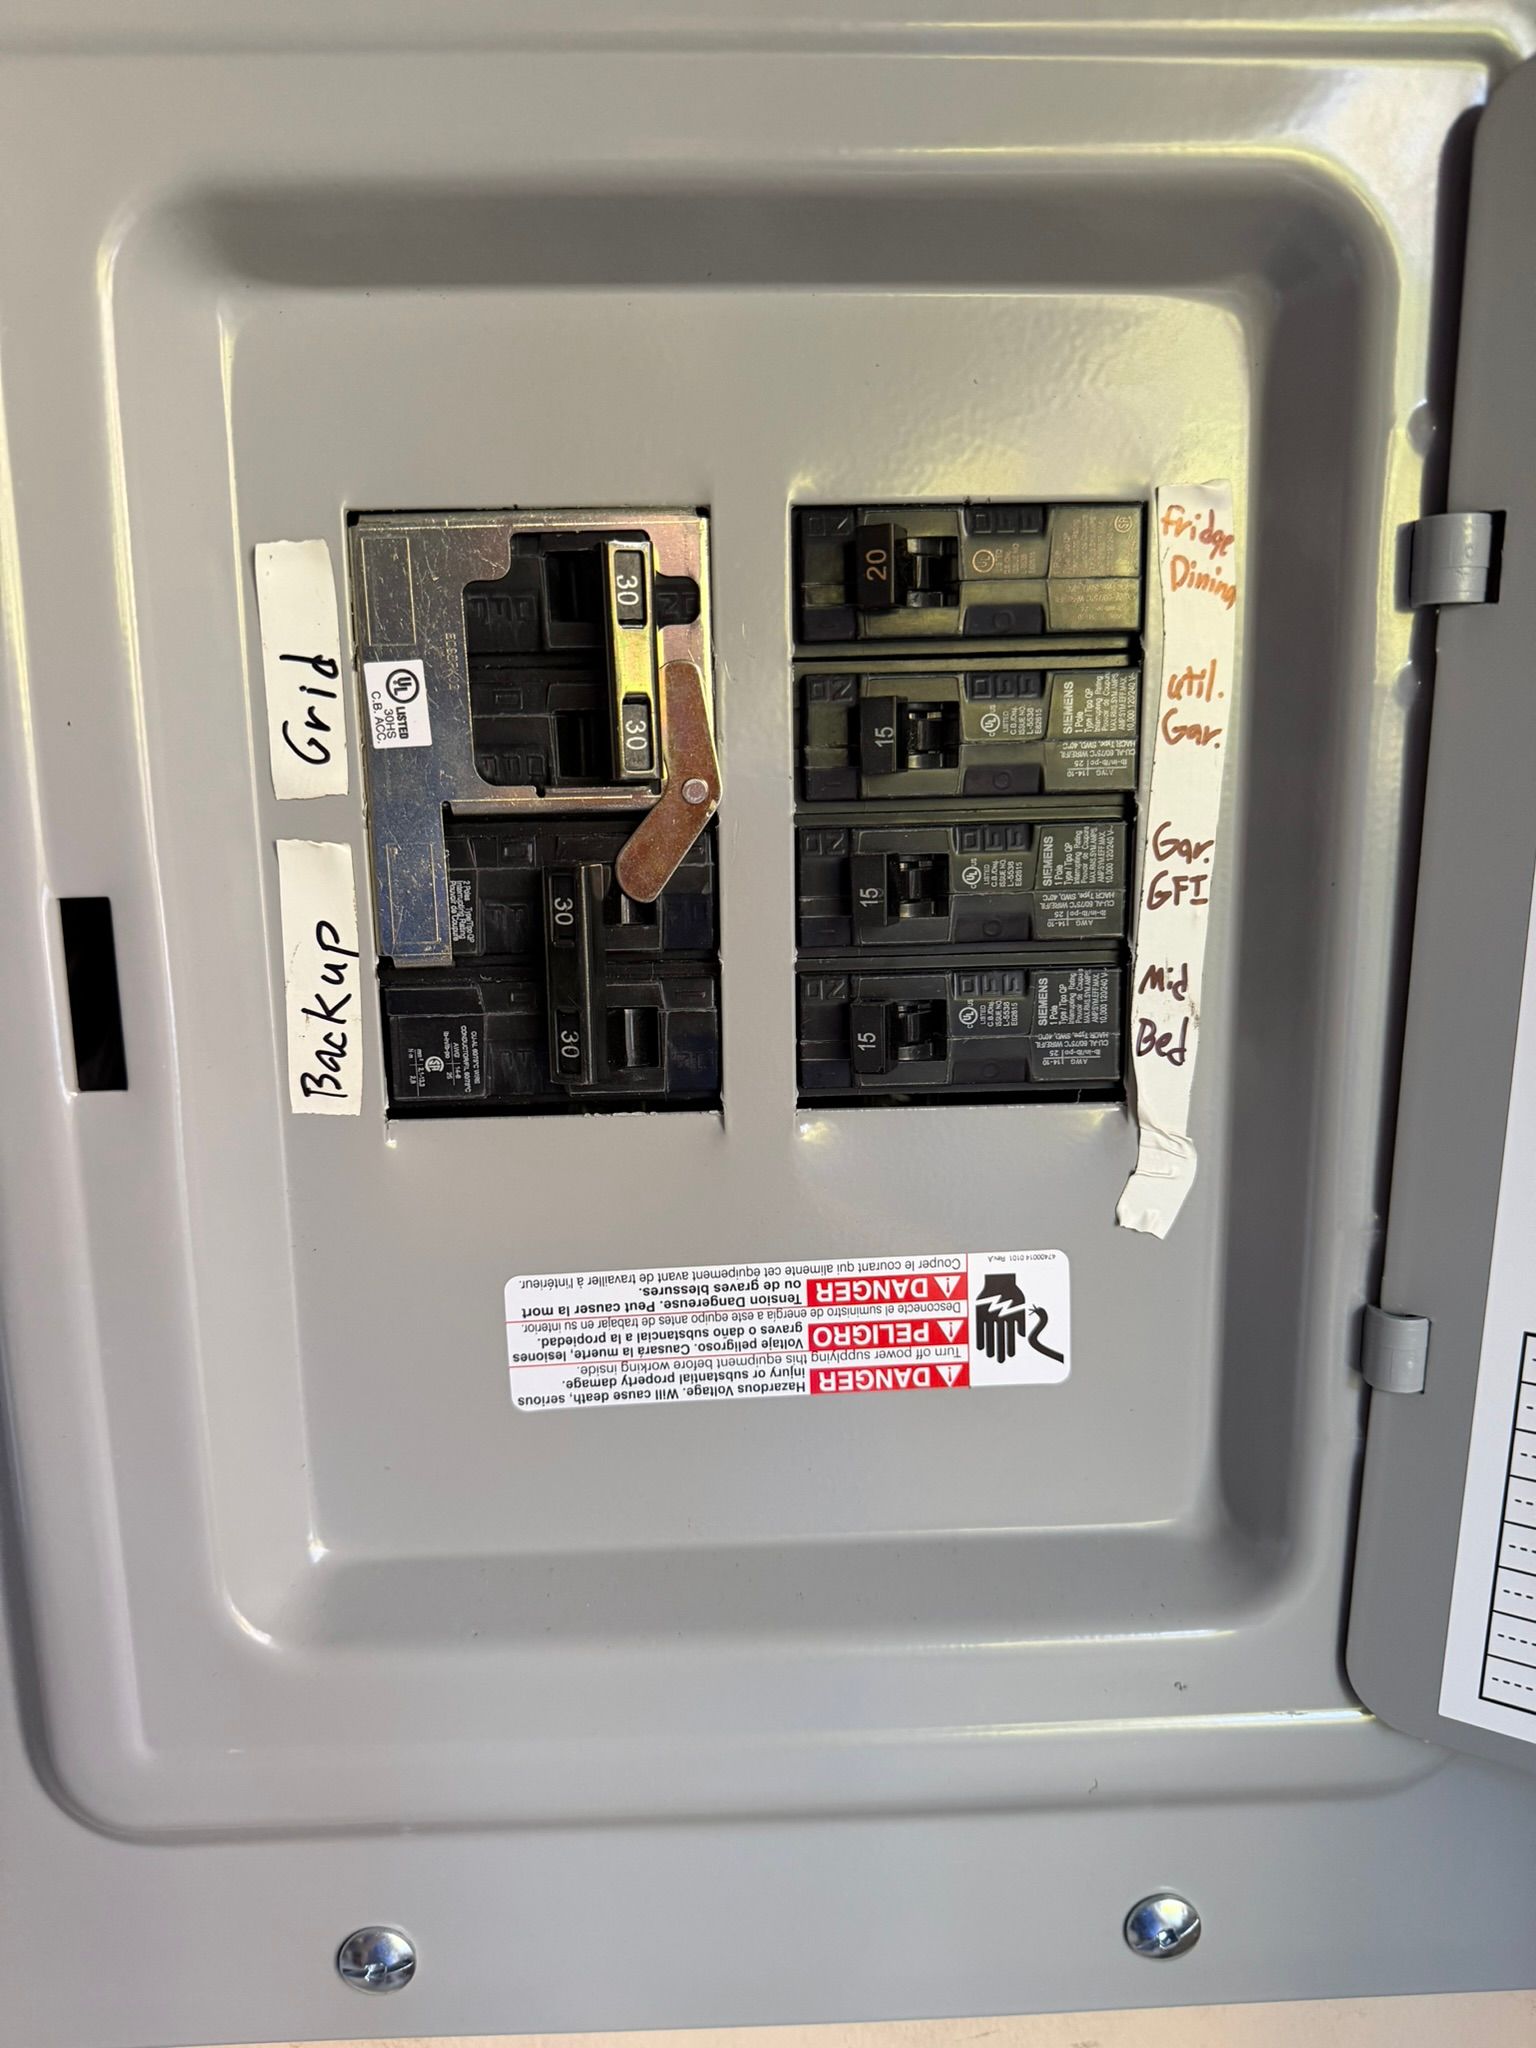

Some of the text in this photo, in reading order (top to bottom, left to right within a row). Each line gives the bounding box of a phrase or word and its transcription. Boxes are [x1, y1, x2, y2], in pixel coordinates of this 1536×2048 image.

[866, 549, 887, 582] 20
[616, 575, 639, 607] 30
[281, 654, 342, 765] Grid
[1064, 681, 1074, 734] SIEMENS
[1085, 700, 1093, 713] Tipo
[371, 691, 386, 744] C.B. ACC.
[385, 709, 396, 739] 30HS
[396, 707, 409, 739] LISTED
[1075, 712, 1083, 727] Pole
[1085, 718, 1093, 733] Type
[625, 720, 649, 751] 30
[875, 726, 894, 748] 15
[1044, 836, 1053, 886] SIEMENS
[1064, 853, 1072, 866] Tipo
[1055, 865, 1063, 880] Pole
[1064, 871, 1072, 885] Type
[860, 887, 879, 907] 15
[1146, 870, 1208, 910] GFI
[553, 897, 574, 926] 30
[302, 920, 360, 1100] Backup
[1039, 978, 1048, 1026] SIEMENS
[1059, 995, 1067, 1006] Tipo
[1050, 1005, 1058, 1019] Pole
[1059, 1011, 1067, 1025] Type
[561, 1030, 580, 1058] 30
[858, 1032, 876, 1051] 15
[1136, 1017, 1188, 1066] Bed
[519, 1255, 960, 1289] Couper le courant qui alimente cet équipement avant de travailler à l'intérieur.
[639, 1278, 801, 1297] ou de graves blessures.
[815, 1277, 928, 1302] DANGER
[522, 1293, 801, 1317] Tension Dangereuse. Peut causer la mort
[766, 1306, 807, 1320] energía
[810, 1308, 824, 1318] de
[826, 1305, 882, 1317] suministro
[885, 1305, 894, 1315] el
[897, 1302, 960, 1314] Desconecte
[564, 1321, 577, 1329] su
[580, 1320, 594, 1328] en
[597, 1315, 638, 1329] trabajar
[641, 1317, 655, 1327] de
[658, 1315, 688, 1326] antes
[690, 1310, 728, 1324] equipo
[731, 1312, 754, 1322] este
[521, 1322, 561, 1334] interior.
[636, 1328, 708, 1340] substancial
[713, 1326, 744, 1337] daño
[760, 1321, 802, 1333] graves
[814, 1323, 928, 1347] PELIGRO
[537, 1330, 606, 1347] propiedad.
[610, 1332, 621, 1342] la
[512, 1336, 803, 1363] Voltaje peligroso. Causará la muerte, lesiones
[577, 1346, 960, 1376] Turn off power supplying this equipment before working inside.
[562, 1365, 804, 1389] injury or substantial property damage.
[819, 1368, 928, 1390] DANGER
[517, 1381, 805, 1406] Hazardous Voltage. Will cause death, serious
